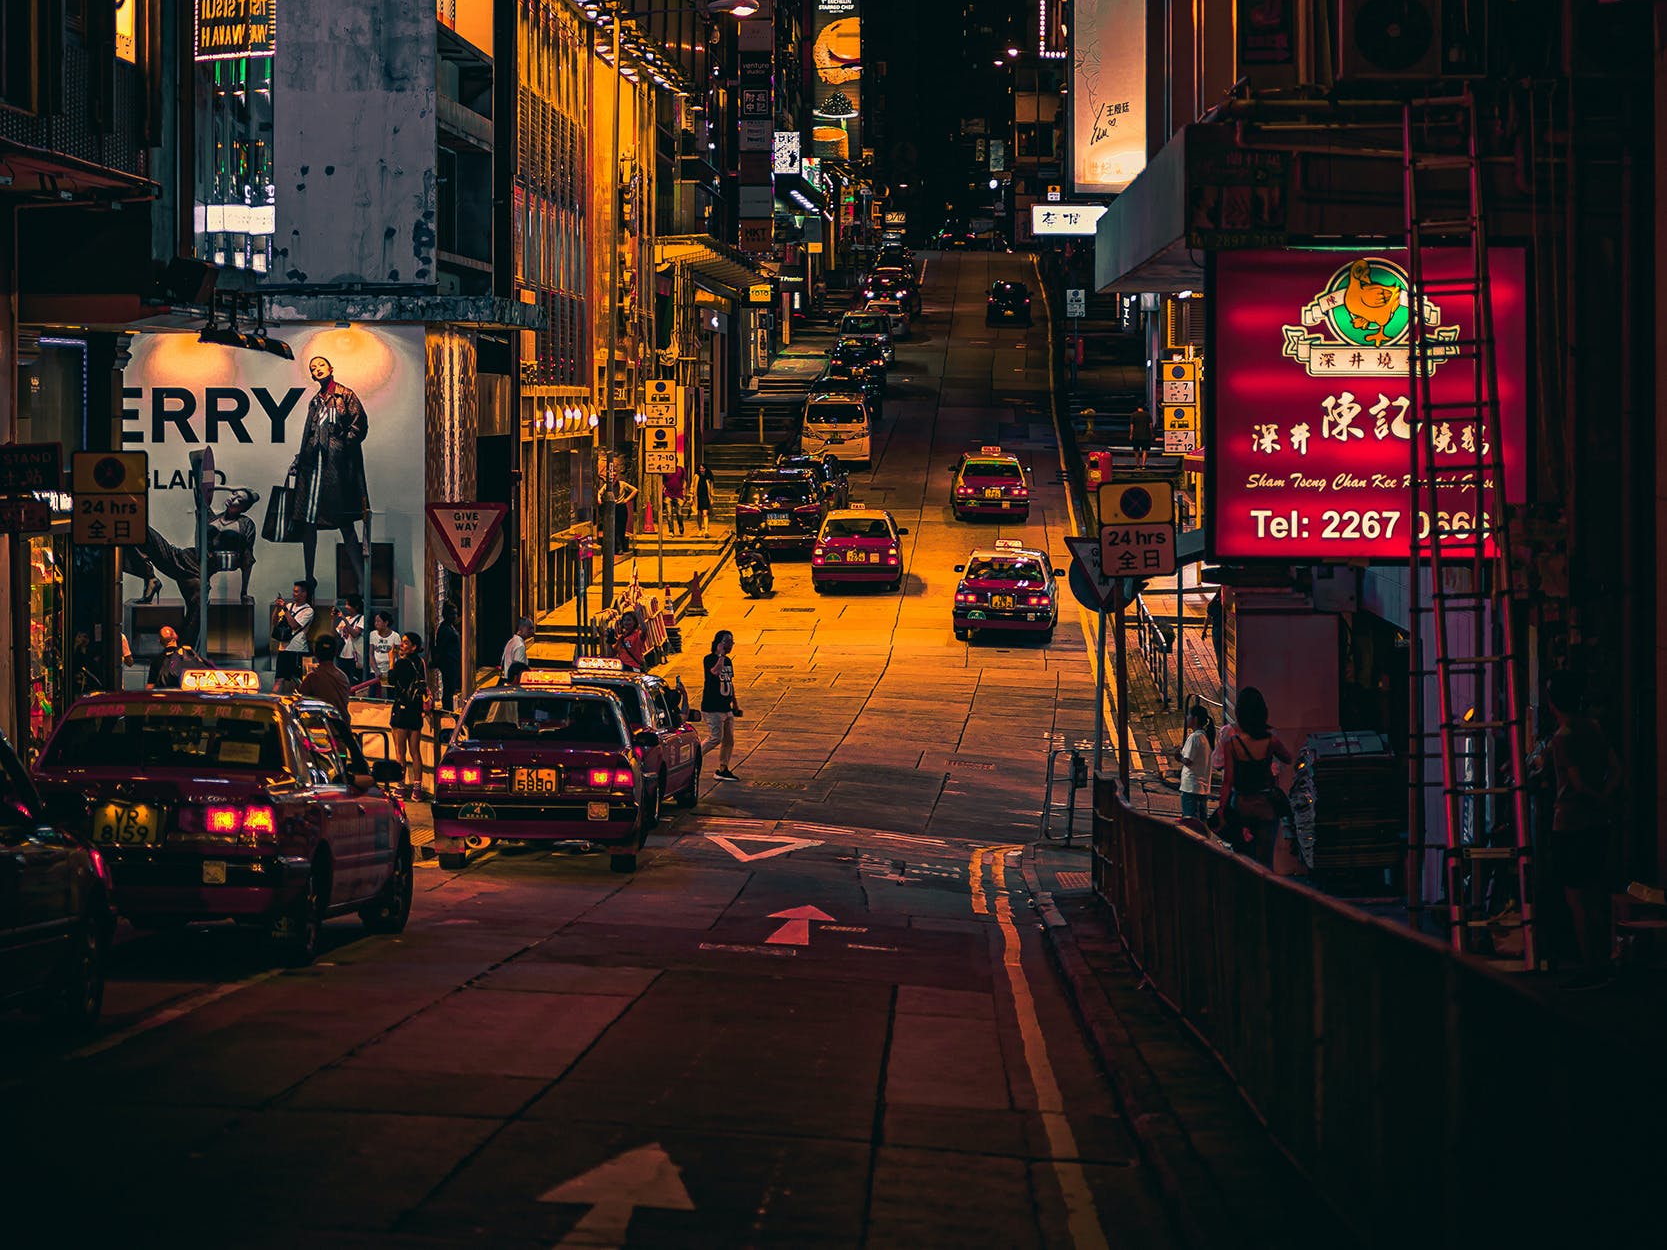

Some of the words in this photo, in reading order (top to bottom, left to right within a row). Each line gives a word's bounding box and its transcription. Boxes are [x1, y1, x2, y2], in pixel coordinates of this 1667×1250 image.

[1245, 473, 1286, 489] Sham
[1289, 472, 1327, 492] Tseng
[1331, 472, 1367, 491] Chan
[1370, 473, 1398, 489] Kee
[82, 500, 105, 515] 24
[110, 500, 138, 515] hrs
[454, 512, 479, 521] GIVE
[1250, 509, 1310, 539] Tel:
[1321, 509, 1401, 539] 2267
[87, 519, 131, 540] 全日
[455, 522, 479, 531] WAY
[1108, 530, 1131, 546] 24
[1135, 530, 1167, 545] hrs
[1117, 549, 1161, 570] 全日
[190, 672, 251, 687] TAXI
[517, 779, 555, 792] 5880
